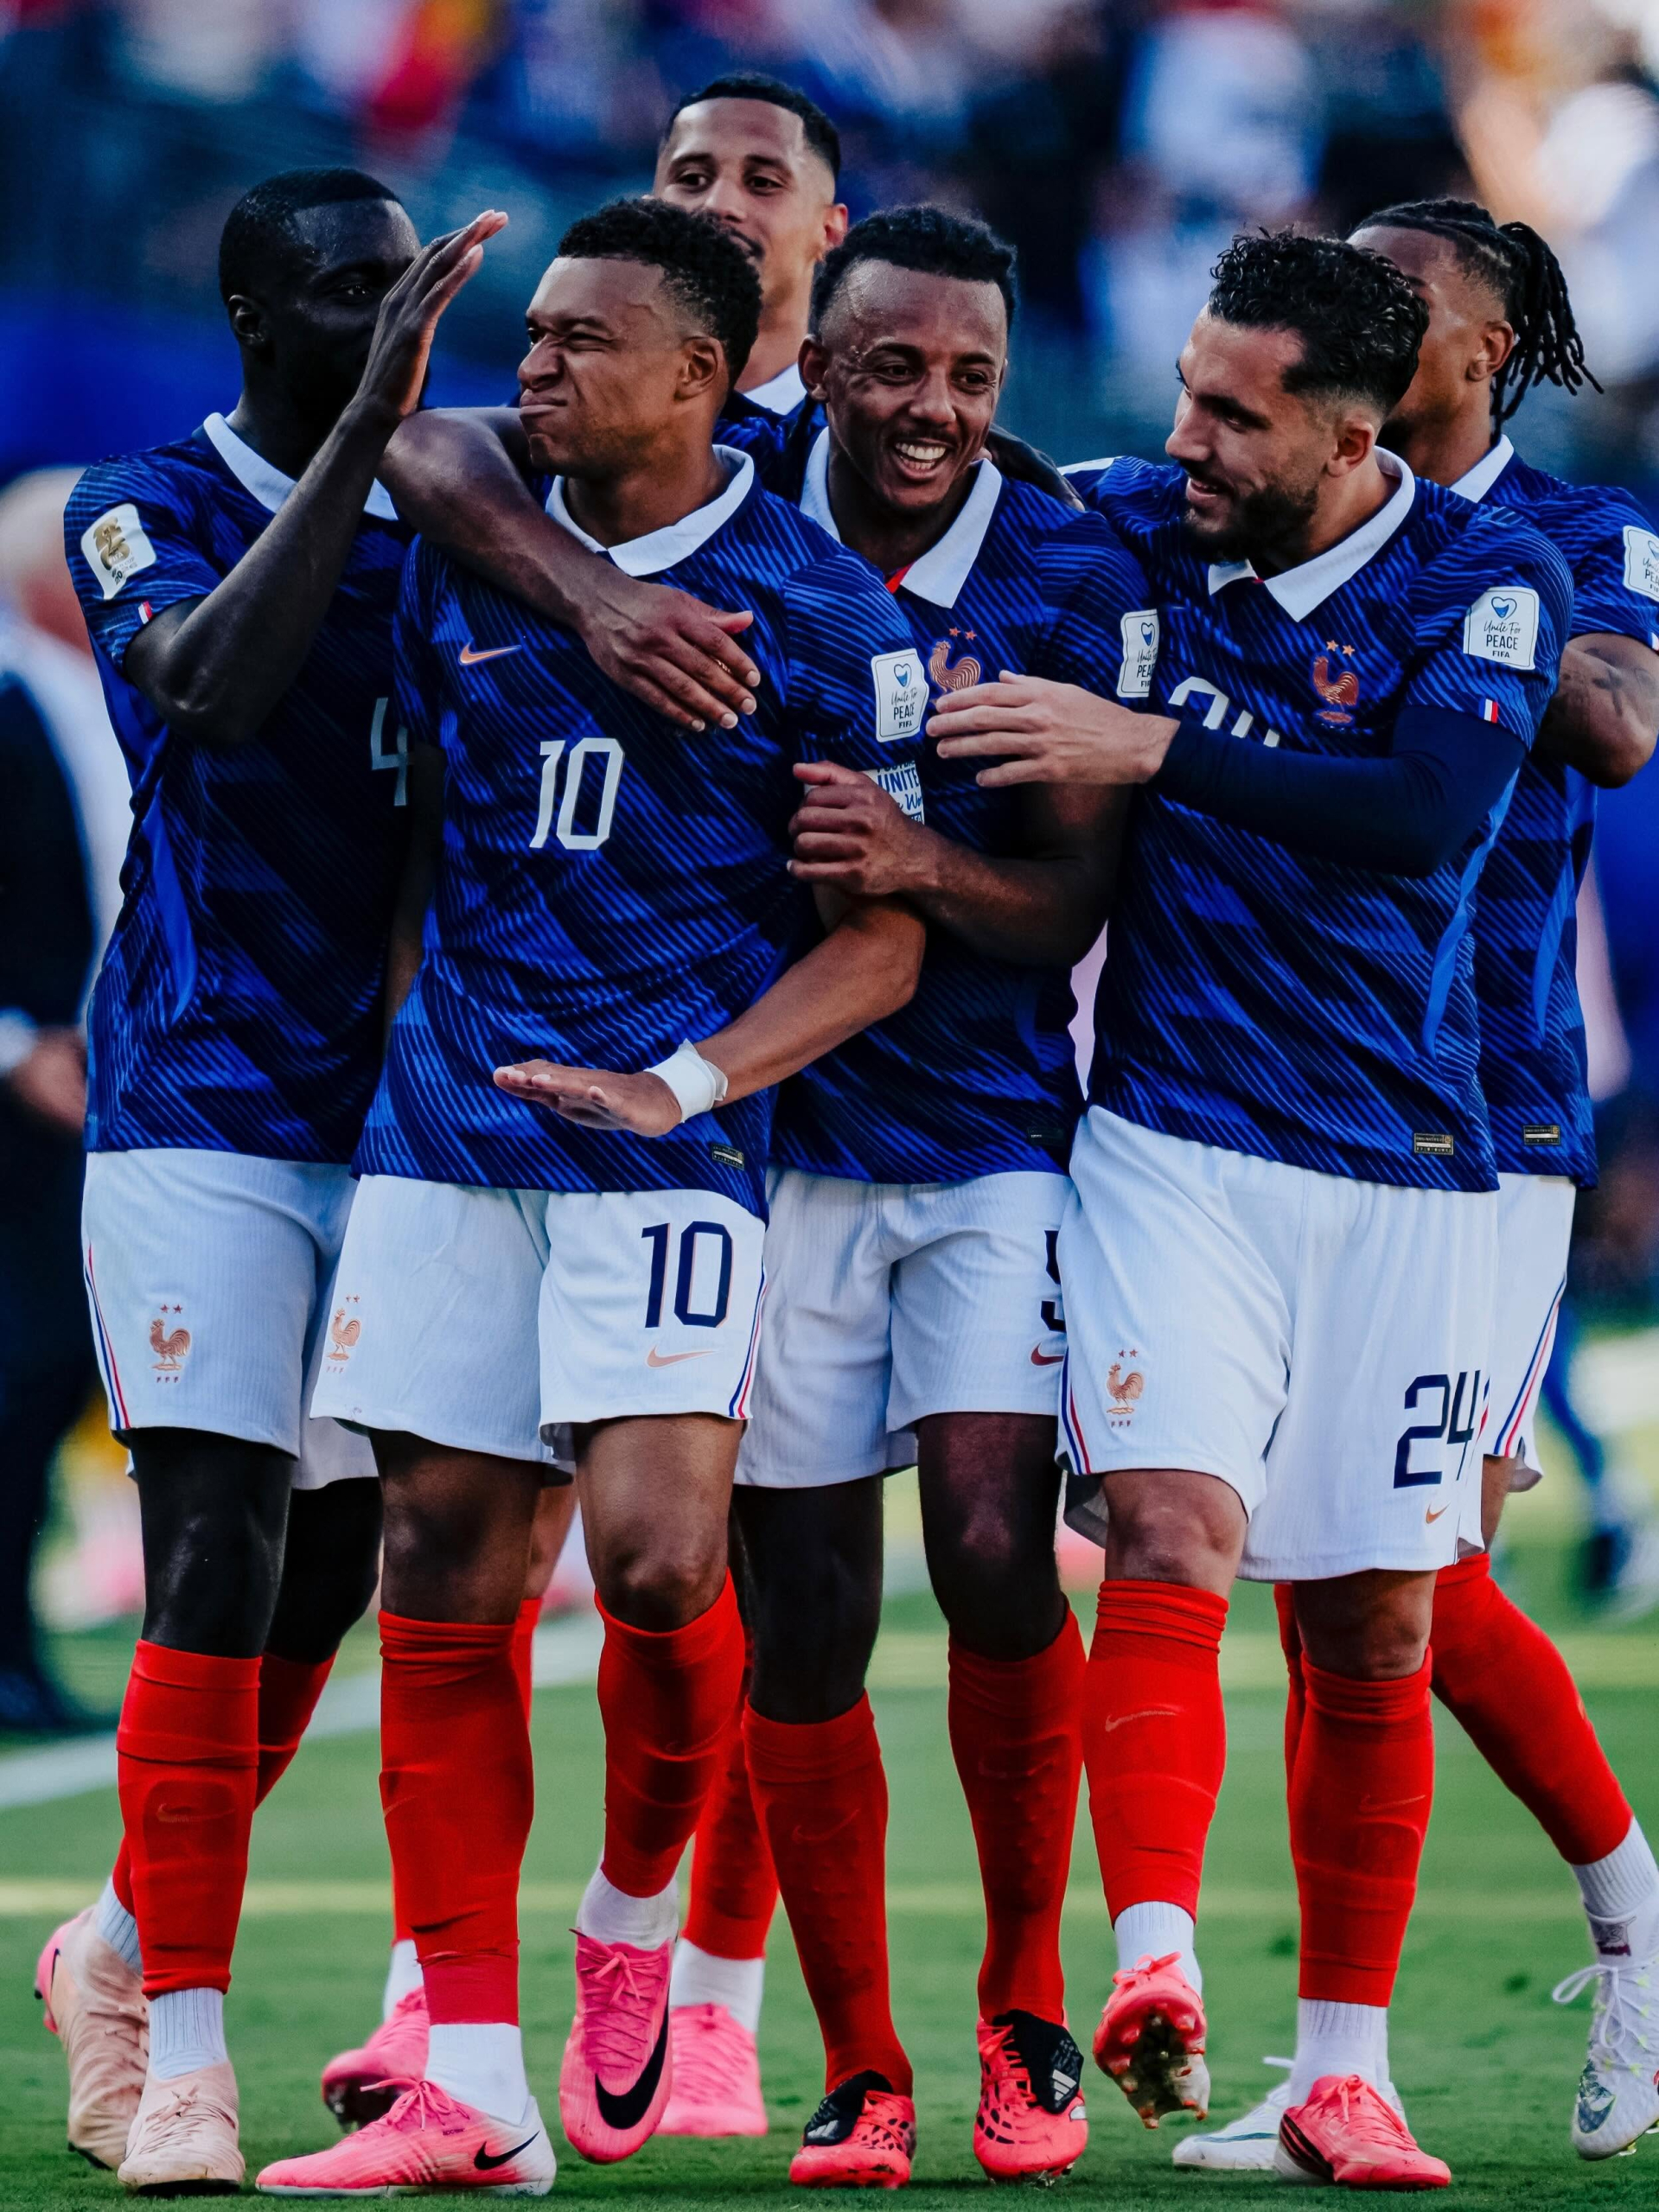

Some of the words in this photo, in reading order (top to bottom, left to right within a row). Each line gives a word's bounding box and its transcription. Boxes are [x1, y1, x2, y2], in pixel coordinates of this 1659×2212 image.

[1484, 620, 1508, 634] Unite
[1509, 622, 1522, 635] For
[1486, 634, 1519, 650] PEACE
[1492, 650, 1510, 659] FIFA
[890, 691, 909, 706] Unite
[1168, 676, 1279, 748] 2
[898, 720, 913, 729] FIFA
[529, 737, 625, 850] 10
[641, 1221, 734, 1328] 10
[1394, 1370, 1481, 1488] 24
